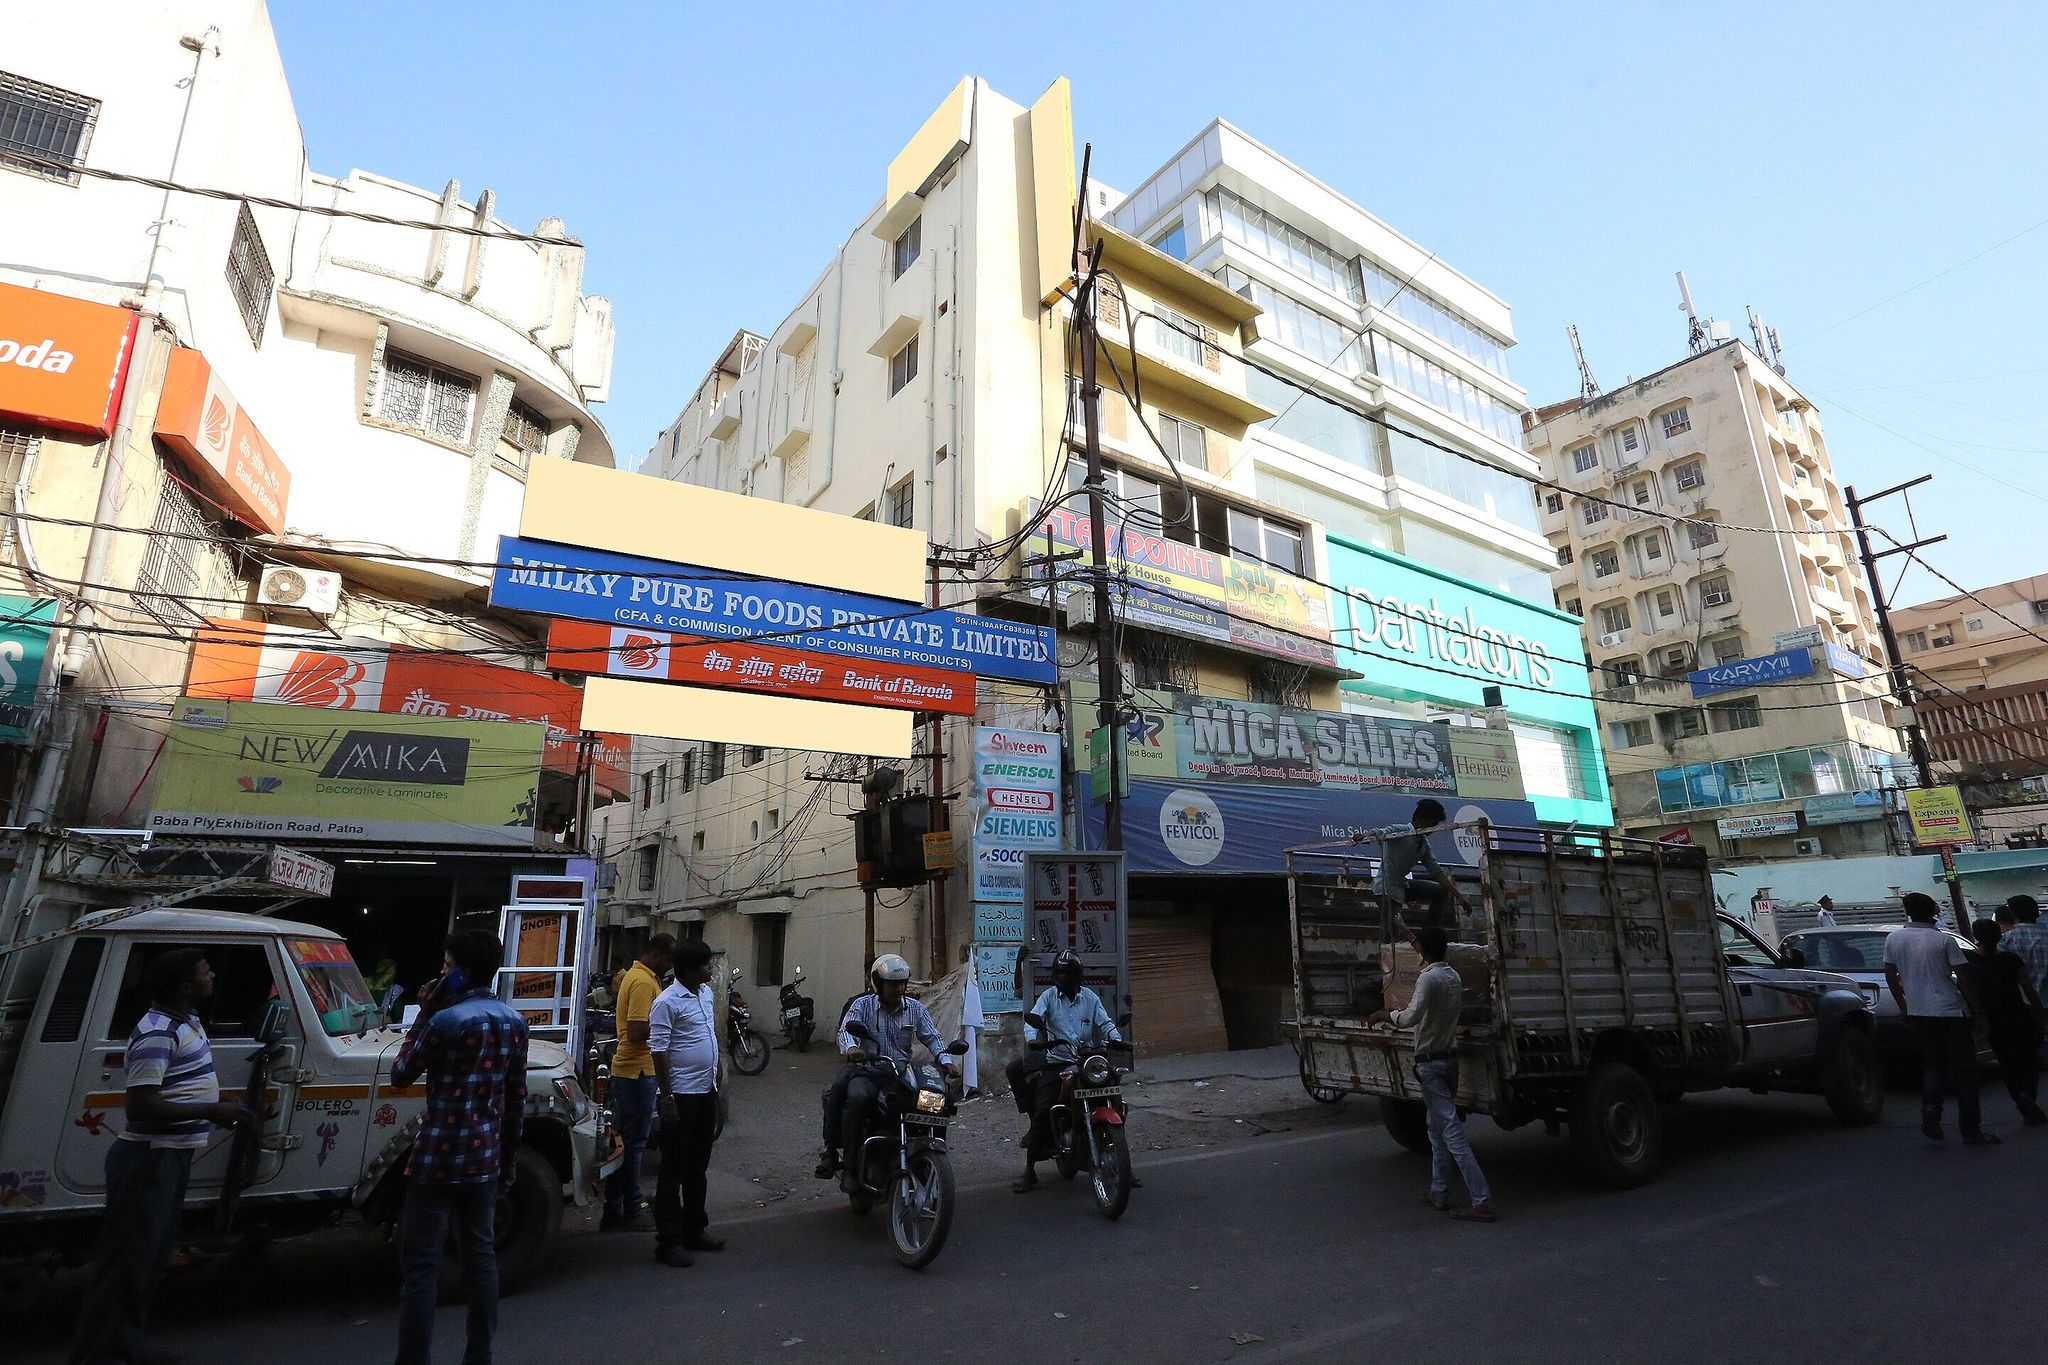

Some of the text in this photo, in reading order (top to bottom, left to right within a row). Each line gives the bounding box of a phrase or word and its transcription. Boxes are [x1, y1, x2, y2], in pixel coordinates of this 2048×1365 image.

[236, 460, 253, 492] Bank
[1124, 528, 1214, 579] POINT
[1135, 567, 1172, 585] House
[1230, 561, 1275, 594] Daily
[1226, 576, 1287, 615] Diet
[508, 556, 1048, 663] MILKY PURE FOODS PRIVATE LIMITED
[614, 607, 650, 623] (CFA
[653, 614, 664, 624] &
[668, 616, 752, 637] COMMISION
[806, 636, 825, 647] OF
[828, 640, 900, 659] CONSUMER
[903, 651, 972, 670] PRODUCTS)
[1346, 584, 1553, 688] pantaloons
[703, 649, 733, 671] बैंक
[1708, 658, 1778, 683] KARVY
[842, 670, 953, 700] Bank of Baroda
[1741, 669, 1792, 683] GROWING
[991, 733, 1047, 754] Shreem
[1190, 705, 1308, 760] MICA
[1315, 717, 1442, 772] SALES
[239, 728, 338, 764] NEW
[335, 743, 448, 778] MIKA
[1141, 750, 1163, 759] Board
[982, 763, 1056, 780] ENERSOL
[1188, 761, 1210, 773] Deals
[1210, 763, 1220, 773] in
[1225, 764, 1261, 777] Plywood,
[1261, 766, 1287, 779] Board,
[1323, 770, 1358, 784] Laminated
[1359, 774, 1381, 787] Board,
[1456, 756, 1513, 783] Heritage
[315, 783, 449, 800] Decorative Laminates
[1002, 793, 1042, 805] HENSEL
[153, 816, 189, 827] Baba
[287, 821, 323, 833] Road,
[328, 823, 364, 834] Patna
[983, 817, 1057, 838] SIEMENS
[1165, 824, 1220, 840] FEVICOL
[1321, 824, 1345, 838] Mica
[1758, 902, 1769, 910] IN
[978, 925, 1023, 937] MADRASA
[295, 1100, 353, 1112] BOLERO
